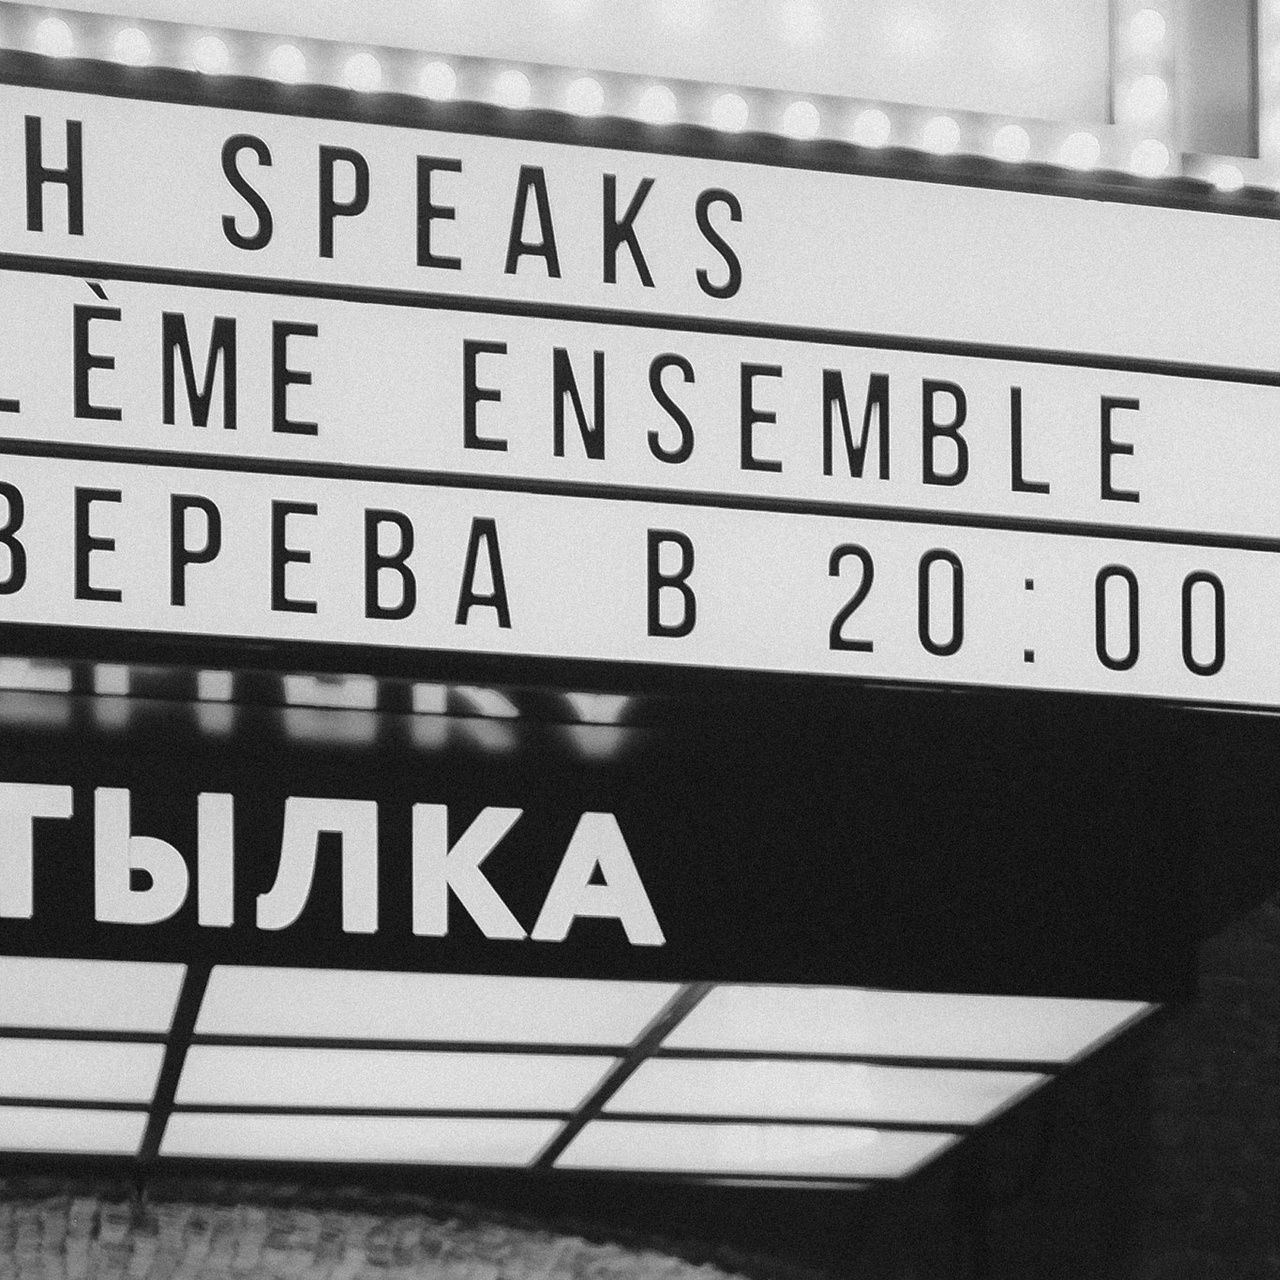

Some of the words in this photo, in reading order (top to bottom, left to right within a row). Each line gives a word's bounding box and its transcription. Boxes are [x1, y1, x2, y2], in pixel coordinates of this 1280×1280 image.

[24, 115, 84, 236] H
[221, 133, 743, 300] SPEAKS
[0, 281, 319, 436] ÈME
[463, 339, 1140, 503] ENSEMBLE
[647, 528, 697, 638] В
[828, 543, 1226, 677] 20:00
[0, 782, 666, 946] ТЫЛКА
